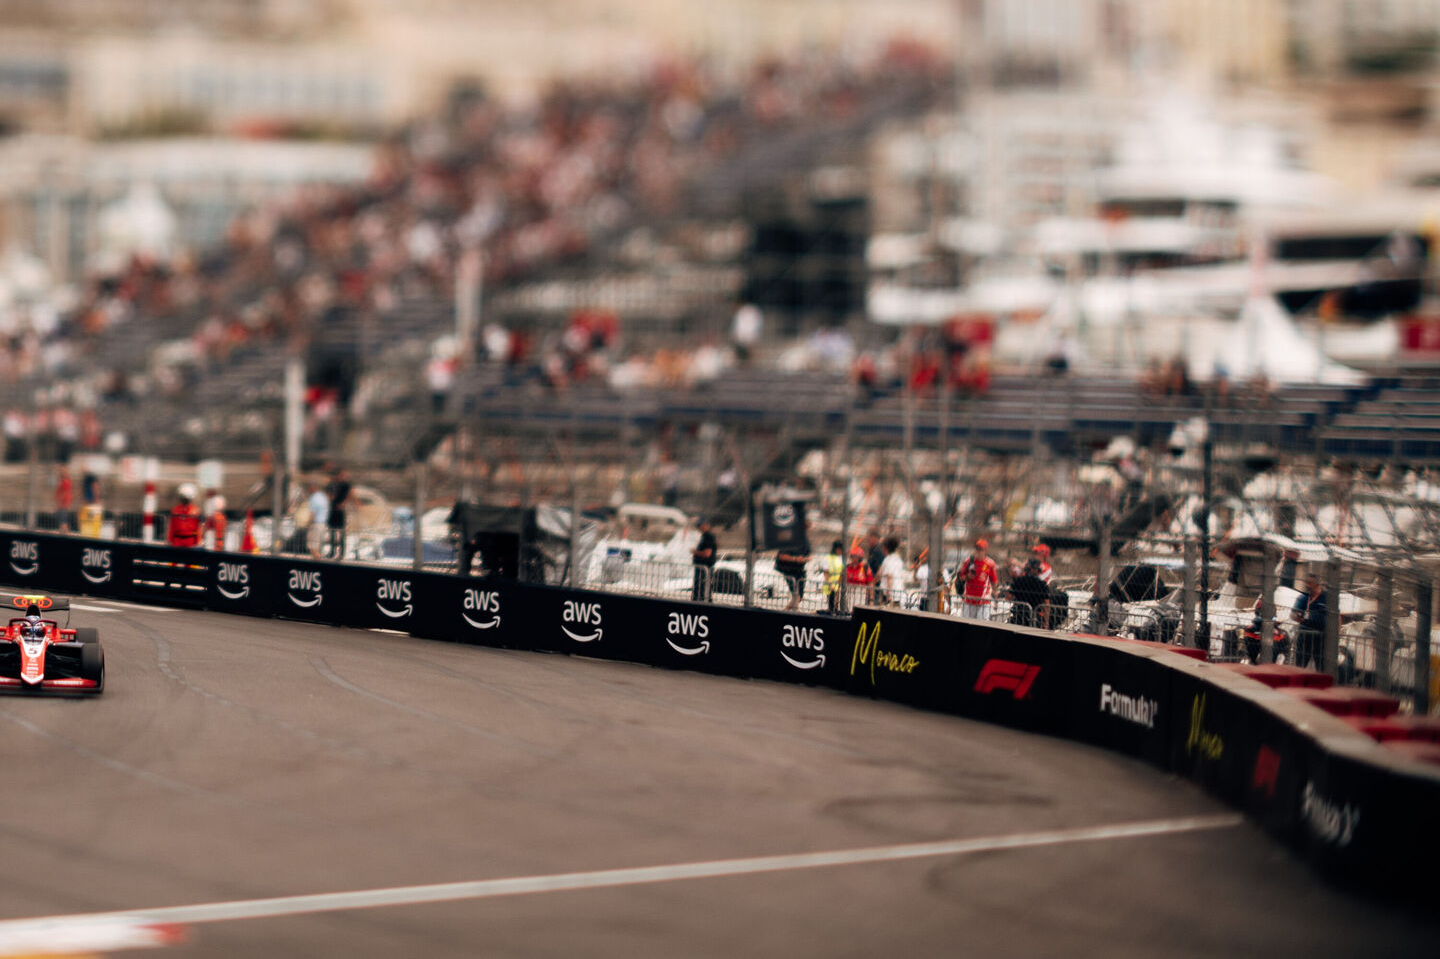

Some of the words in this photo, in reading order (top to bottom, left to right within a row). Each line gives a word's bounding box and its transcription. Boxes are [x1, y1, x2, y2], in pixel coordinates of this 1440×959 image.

[10, 541, 38, 560] aws
[82, 549, 111, 568] aws
[218, 563, 249, 583] aws
[289, 570, 322, 592] aws
[377, 579, 412, 601] aws
[464, 589, 500, 612] aws
[563, 601, 602, 625] aws
[668, 613, 709, 637] aws
[782, 625, 825, 651] aws
[850, 620, 920, 685] Monaco
